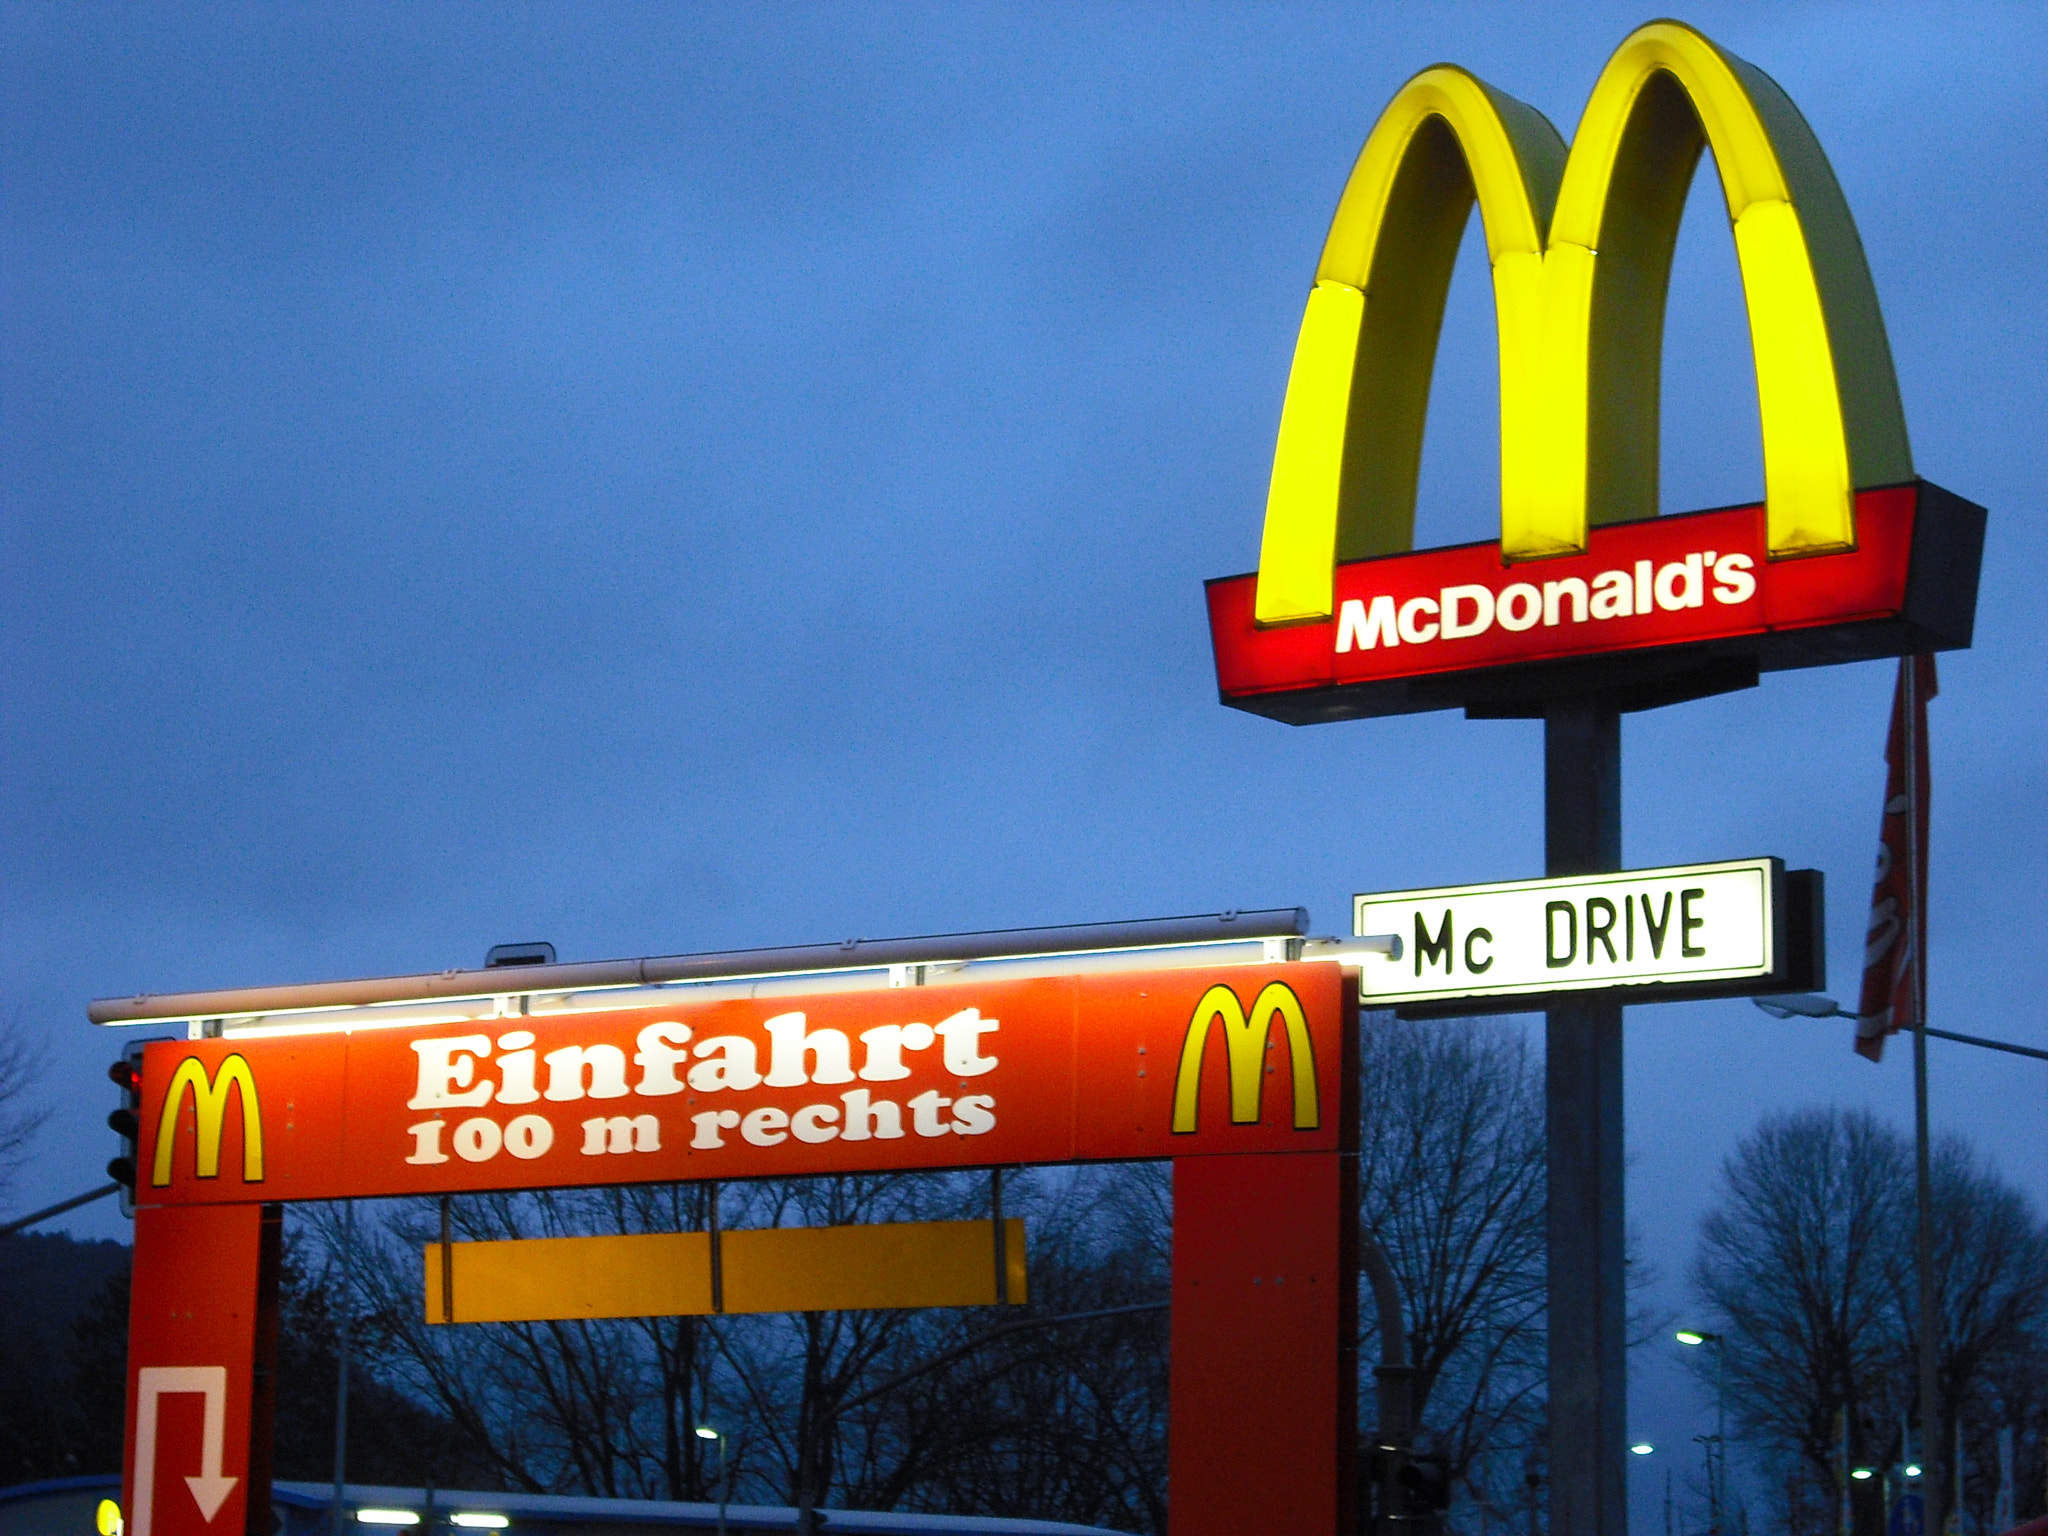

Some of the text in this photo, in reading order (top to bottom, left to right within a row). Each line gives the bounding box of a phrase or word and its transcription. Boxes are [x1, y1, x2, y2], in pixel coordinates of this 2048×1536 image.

[1334, 551, 1756, 654] McDonald's
[1413, 888, 1706, 978] Mc DRIVE
[406, 1007, 1000, 1111] Einfahrt
[404, 1088, 996, 1165] 100 m rechts
